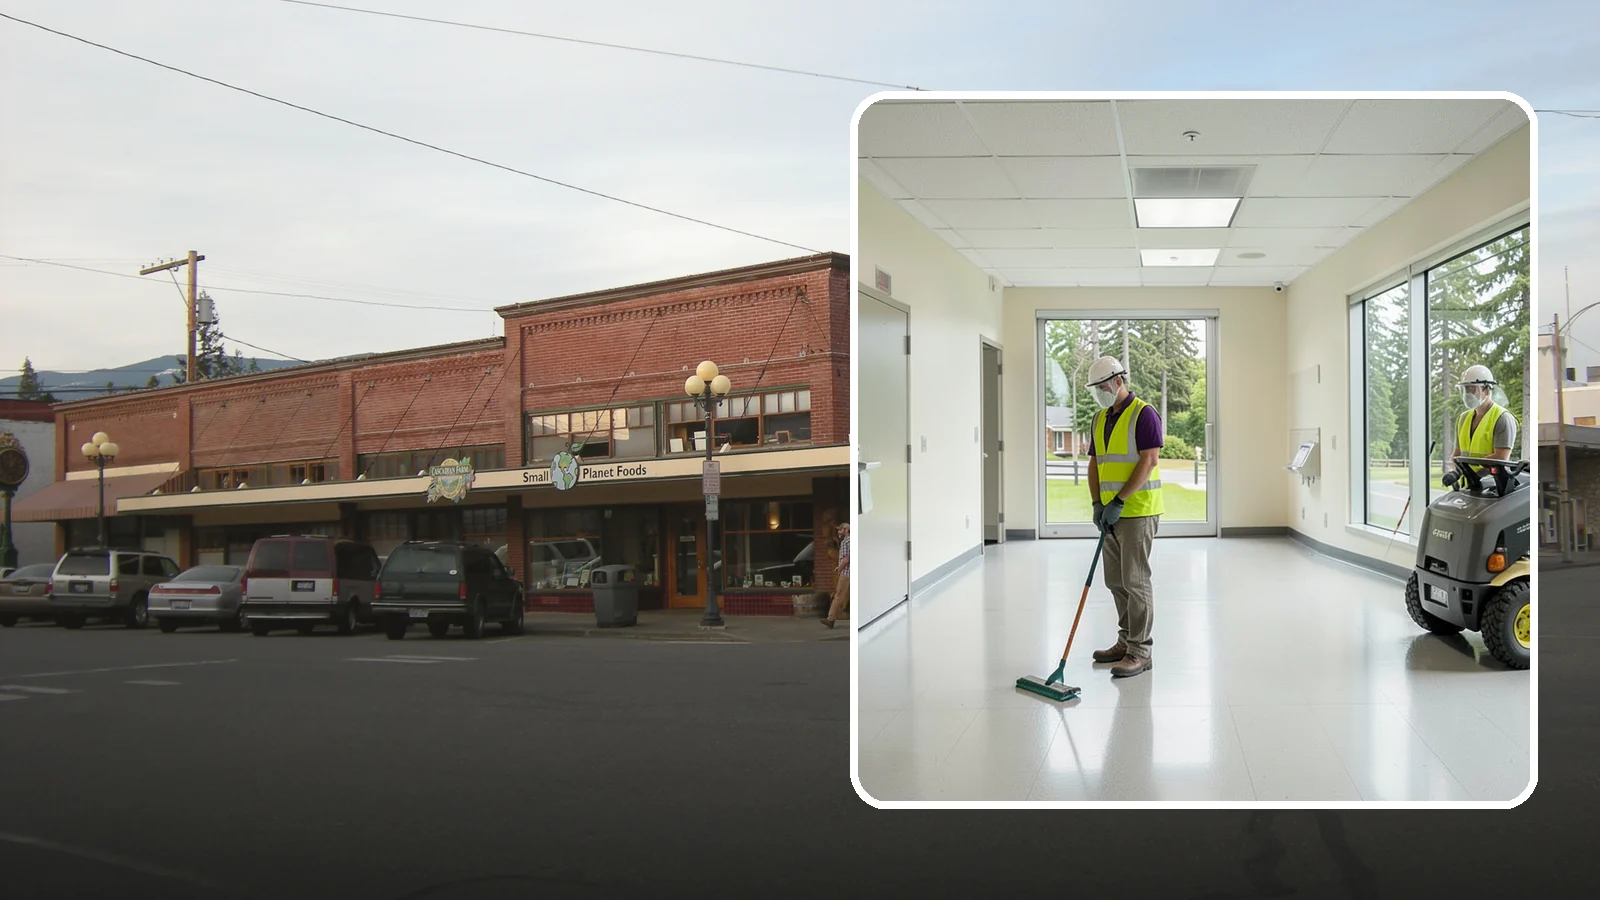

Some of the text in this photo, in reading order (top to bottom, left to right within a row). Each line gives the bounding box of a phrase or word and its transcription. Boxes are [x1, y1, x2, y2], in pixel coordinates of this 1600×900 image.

[523, 464, 647, 483] Small Planet Foods
